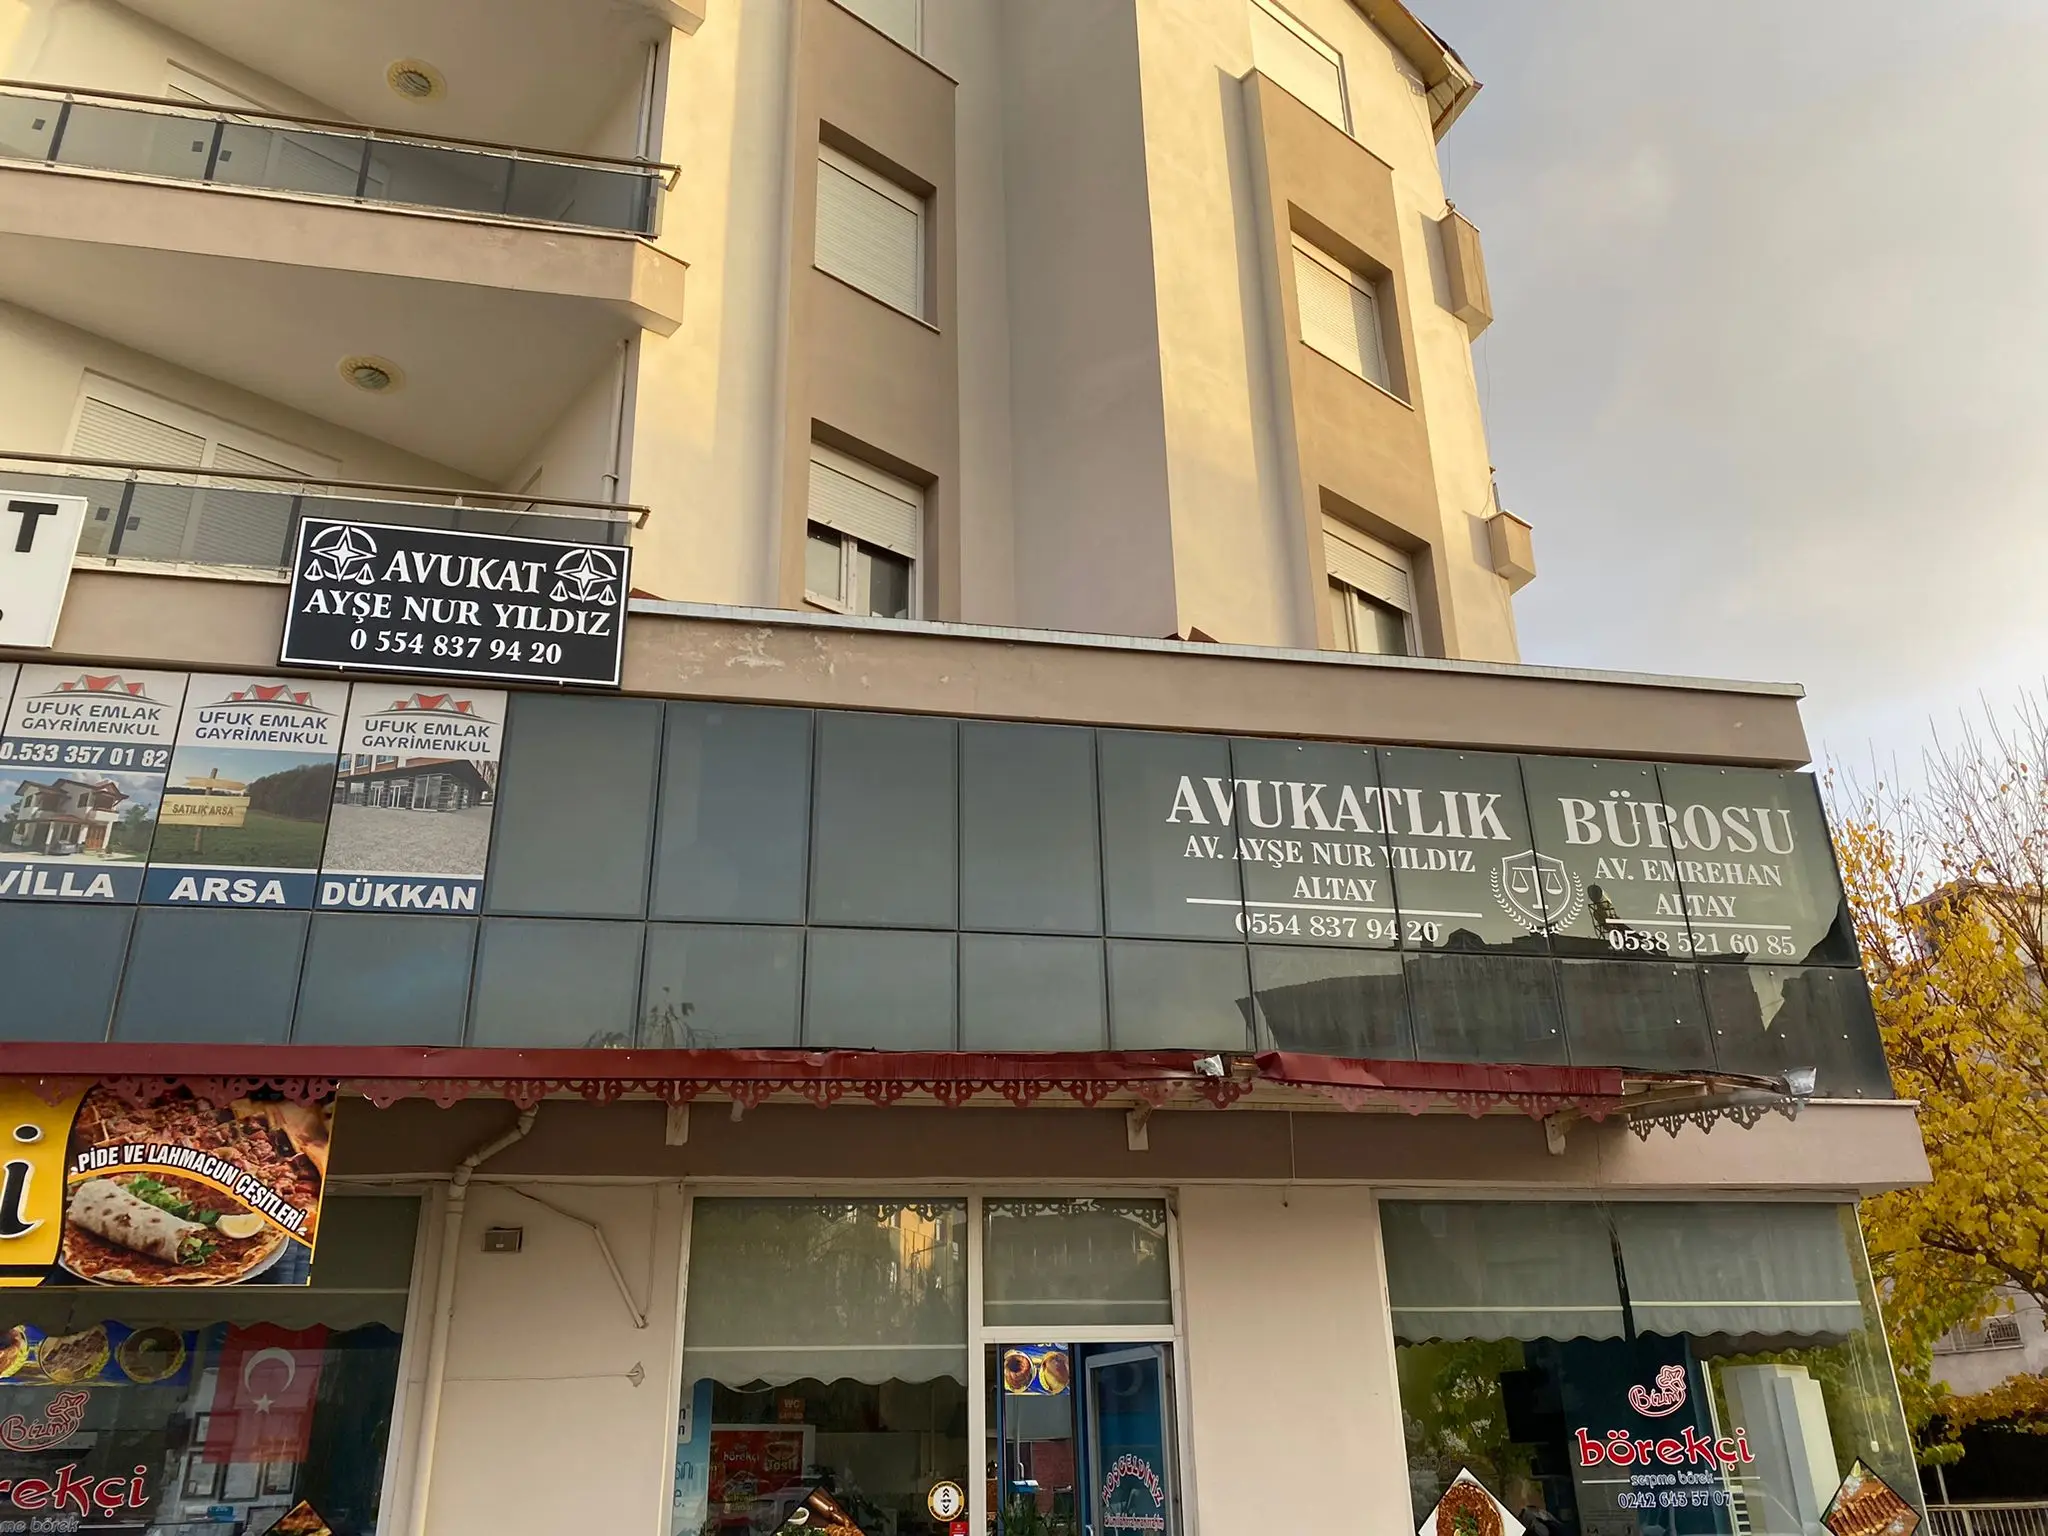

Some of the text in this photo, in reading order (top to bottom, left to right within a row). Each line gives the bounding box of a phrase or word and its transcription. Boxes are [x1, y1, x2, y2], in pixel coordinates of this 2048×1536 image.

[381, 550, 547, 594] AVUKAT
[302, 588, 610, 637] AYŞE NUR YILDIZ
[350, 630, 562, 665] 0 554 837 94 20
[26, 701, 161, 721] UFUK EMLAK
[199, 711, 328, 730] UFUK EMLAK
[21, 717, 160, 736] GAYRİMENKUL
[195, 726, 328, 745] GAYRİMENKUL
[365, 719, 490, 738] UFUK EMLAK
[0, 742, 169, 768] 0.533 357 01 82
[362, 733, 491, 753] GAYRİMENKUL
[208, 804, 234, 816] ARSA
[1165, 775, 1796, 855] AVUKATLIK BÜROSU
[1184, 835, 1476, 873] AV. AYŞE NUR YILDIZ
[0, 865, 114, 898] VİLLA
[1594, 857, 1782, 887] AV. EMREHAN
[168, 876, 286, 904] ARSA
[321, 877, 477, 910] DÜKKAN
[1293, 876, 1377, 902] ALTAY
[1656, 892, 1736, 918] ALTAY
[1234, 912, 1439, 942] 0554 837 94 20
[1609, 929, 1796, 956] 0538 521 60 85
[78, 1144, 306, 1232] PİDE VE LAHMACUN ÇEŞİTLERİ
[1575, 1426, 1755, 1471] börekçi
[1630, 1470, 1714, 1489] serpme börek
[30, 1516, 80, 1533] börek
